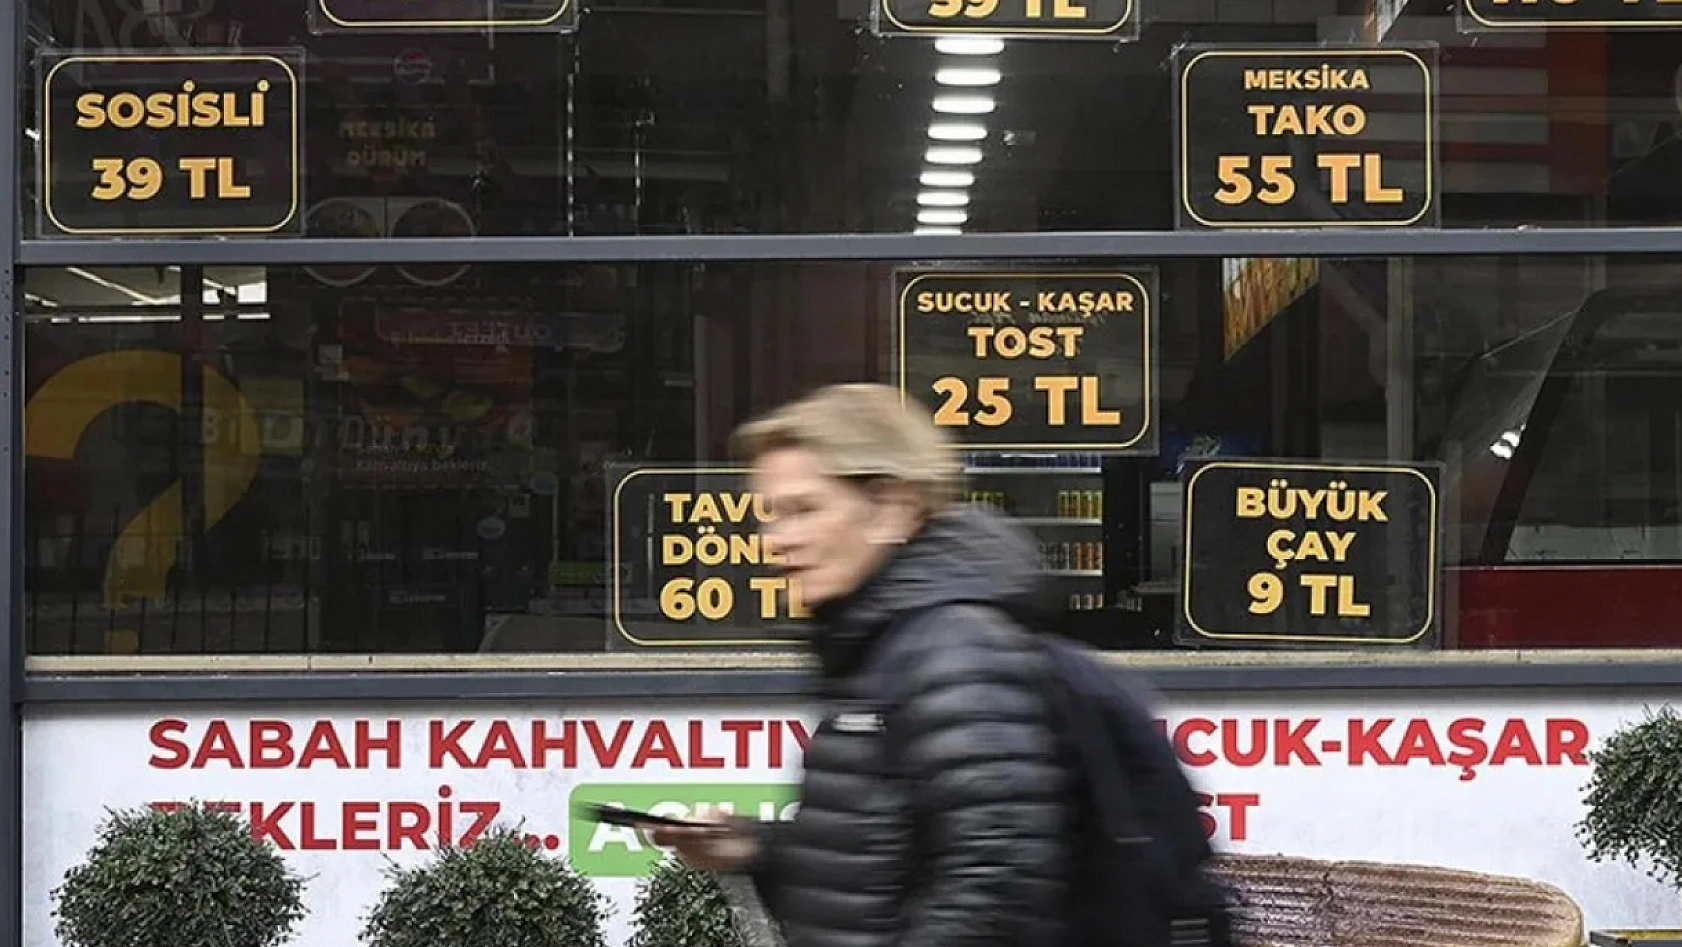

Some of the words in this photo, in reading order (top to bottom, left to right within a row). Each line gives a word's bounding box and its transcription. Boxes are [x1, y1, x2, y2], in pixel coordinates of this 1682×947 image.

[1243, 64, 1369, 90] MEKSİKA
[75, 80, 270, 128] SOSİSLİ
[1247, 104, 1367, 135] TAKO
[91, 156, 163, 200] 39
[179, 156, 251, 199] TL
[1214, 155, 1296, 205] 55
[1316, 153, 1404, 204] TL
[917, 290, 1012, 313] SUCUK
[1036, 290, 1134, 318] KAŞAR
[966, 325, 1085, 359] TOST
[931, 376, 1014, 427] 25
[1034, 375, 1122, 426] TL
[663, 492, 778, 523] TAVU
[1235, 479, 1389, 523] BÜYÜK
[662, 525, 787, 566] DÖNE
[1266, 529, 1356, 570] ÇAY
[659, 576, 734, 621] 60
[749, 577, 815, 619] TL
[1246, 572, 1285, 615] 9
[1300, 574, 1371, 618] TL
[148, 719, 402, 770] SABAH
[429, 719, 811, 769] KAHVALTIY
[146, 784, 560, 850] KLERİZ...
